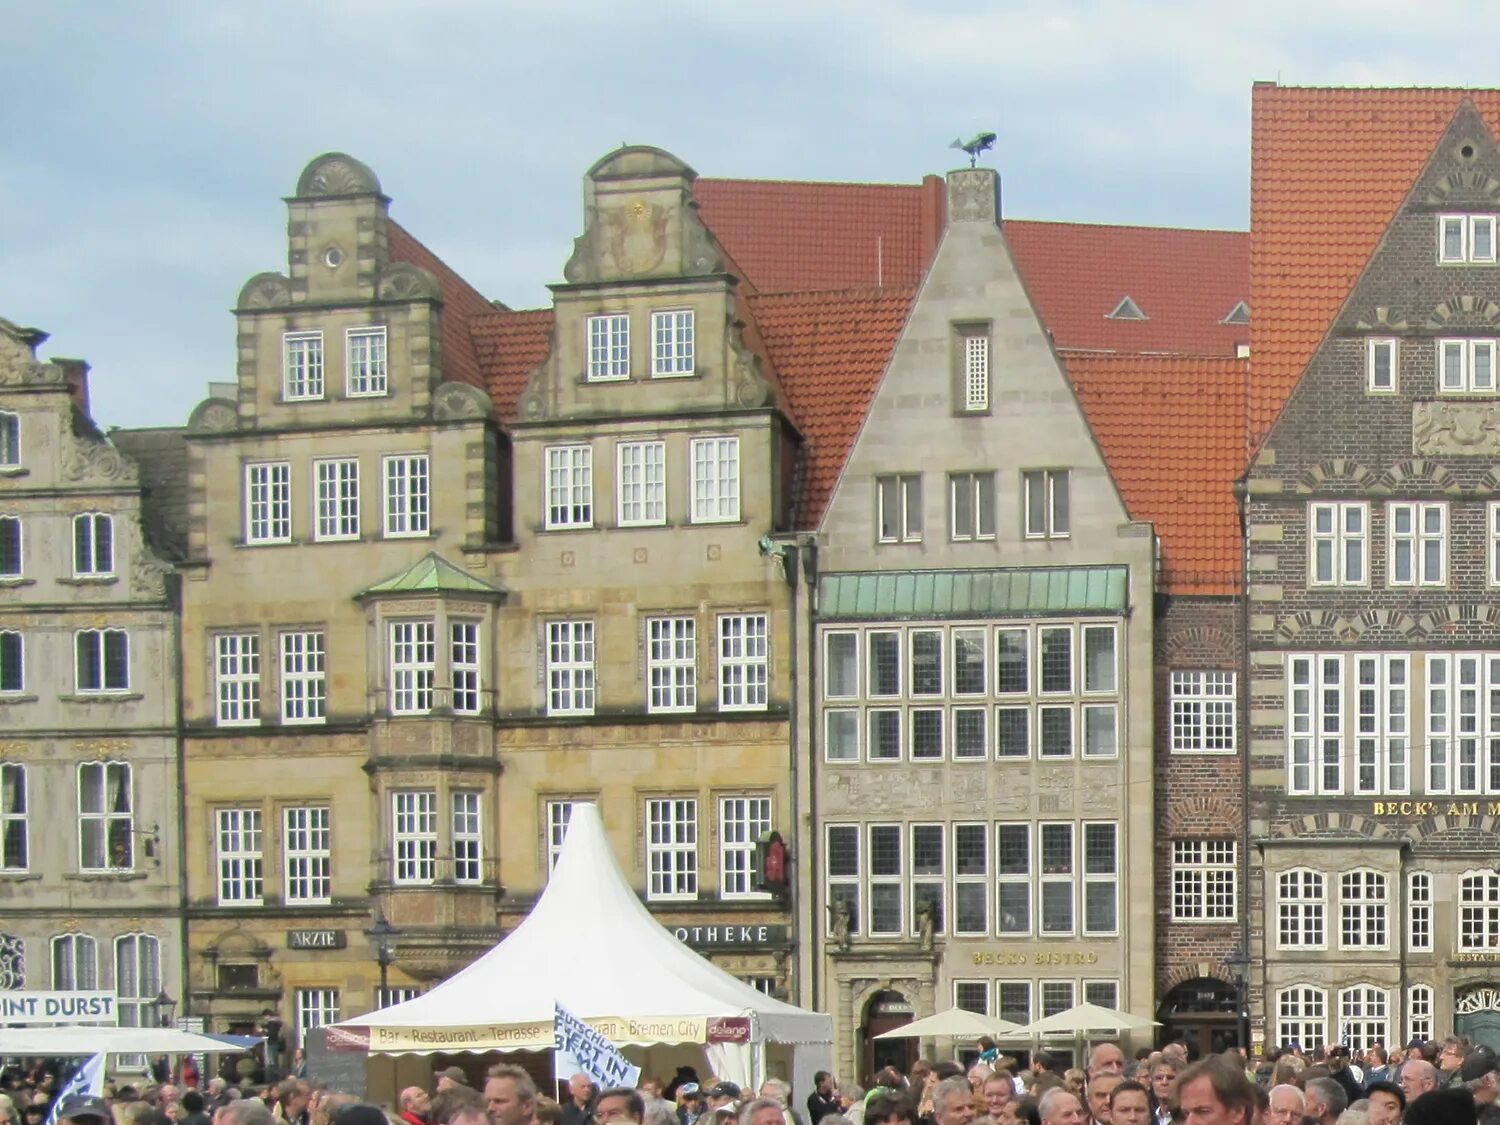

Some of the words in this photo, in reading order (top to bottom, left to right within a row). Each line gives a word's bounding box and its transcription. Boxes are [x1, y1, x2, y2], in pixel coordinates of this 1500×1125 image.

[1448, 802, 1479, 815] AM
[0, 998, 38, 1016] INT
[46, 997, 113, 1016] DURST
[379, 1029, 399, 1044] Bar
[413, 1028, 478, 1043] Restaurant
[489, 1026, 540, 1041] Terrasse
[629, 1020, 674, 1036] Bremen
[678, 1020, 700, 1038] City
[606, 1056, 629, 1081] IN
